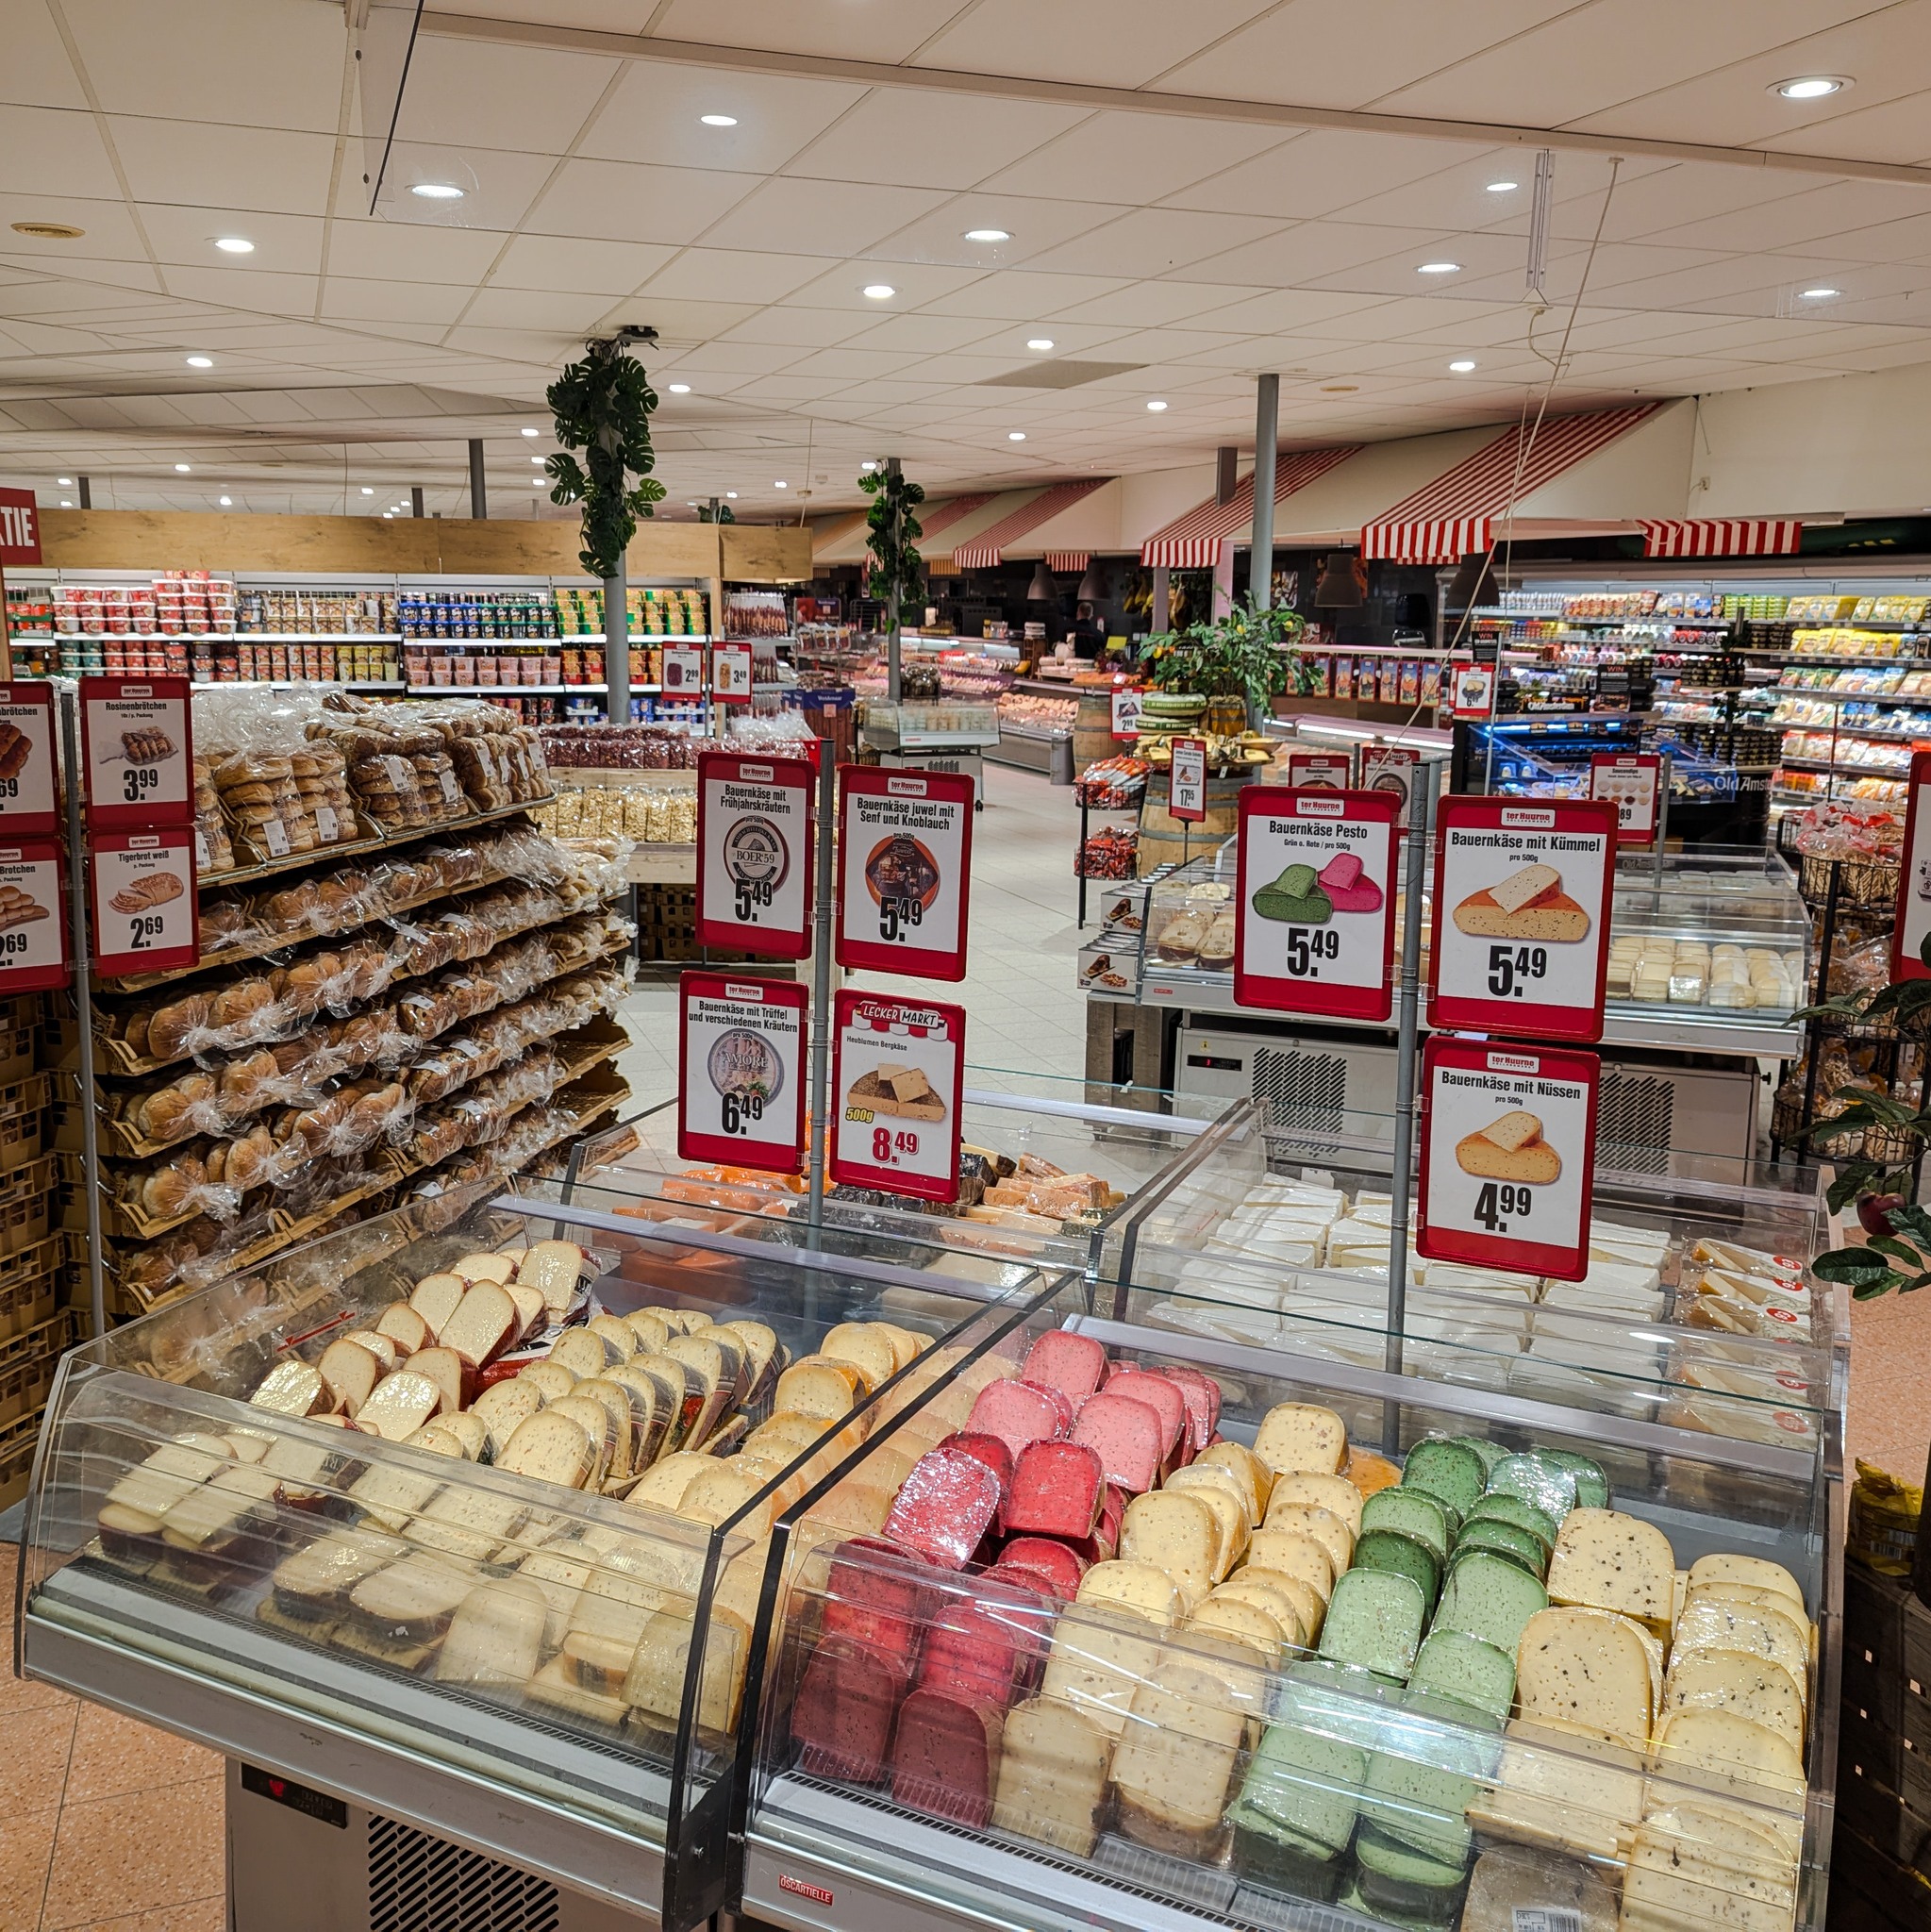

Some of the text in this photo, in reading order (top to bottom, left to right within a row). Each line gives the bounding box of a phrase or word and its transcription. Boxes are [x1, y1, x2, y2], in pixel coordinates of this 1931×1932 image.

[0, 506, 36, 547] TIE
[0, 707, 38, 716] brötchen
[106, 702, 167, 710] Rosinenbrötchen
[124, 769, 158, 802] 3.99
[724, 784, 787, 802] Bauernkäse mit
[1714, 775, 1740, 791] Old
[720, 796, 791, 814] Frühjahrskräutern
[857, 797, 955, 818] Bauernkäse juwel mit
[1312, 801, 1340, 809] Huurne
[860, 809, 950, 830] Senf und Knoblauch
[1507, 811, 1551, 821] ter Huurne
[1269, 820, 1368, 839] Bauernkäse Pesto
[1284, 839, 1298, 847] Grün
[1336, 842, 1351, 851] 500g
[1451, 832, 1601, 852] Bauernkäse mit Kümmel
[118, 850, 170, 863] Tigerbrot weiß
[1509, 854, 1539, 863] pro 500g
[735, 878, 773, 923] 5.49
[879, 896, 923, 941] 5.49
[130, 915, 164, 949] 2.69
[1287, 927, 1340, 977] 5.49
[1488, 944, 1548, 998] 5.49
[698, 1000, 788, 1020] Bauernkäse mit Trüffel
[863, 1005, 937, 1026] LECKER MARKT
[689, 1012, 798, 1033] und verschiedenen Kräutern
[846, 1035, 907, 1052] Heublumen Bergkäse
[723, 1052, 769, 1068] AMORE
[1505, 1057, 1535, 1067] Huurne
[1441, 1070, 1581, 1100] Bauernkäse mit Nüssen
[1507, 1096, 1523, 1106] 500g
[721, 1091, 763, 1135] 6.49
[845, 1107, 874, 1124] 500g
[872, 1126, 920, 1165] 8.49
[1473, 1182, 1532, 1233] 4.99
[780, 1877, 831, 1903] OSCARTIELLE
